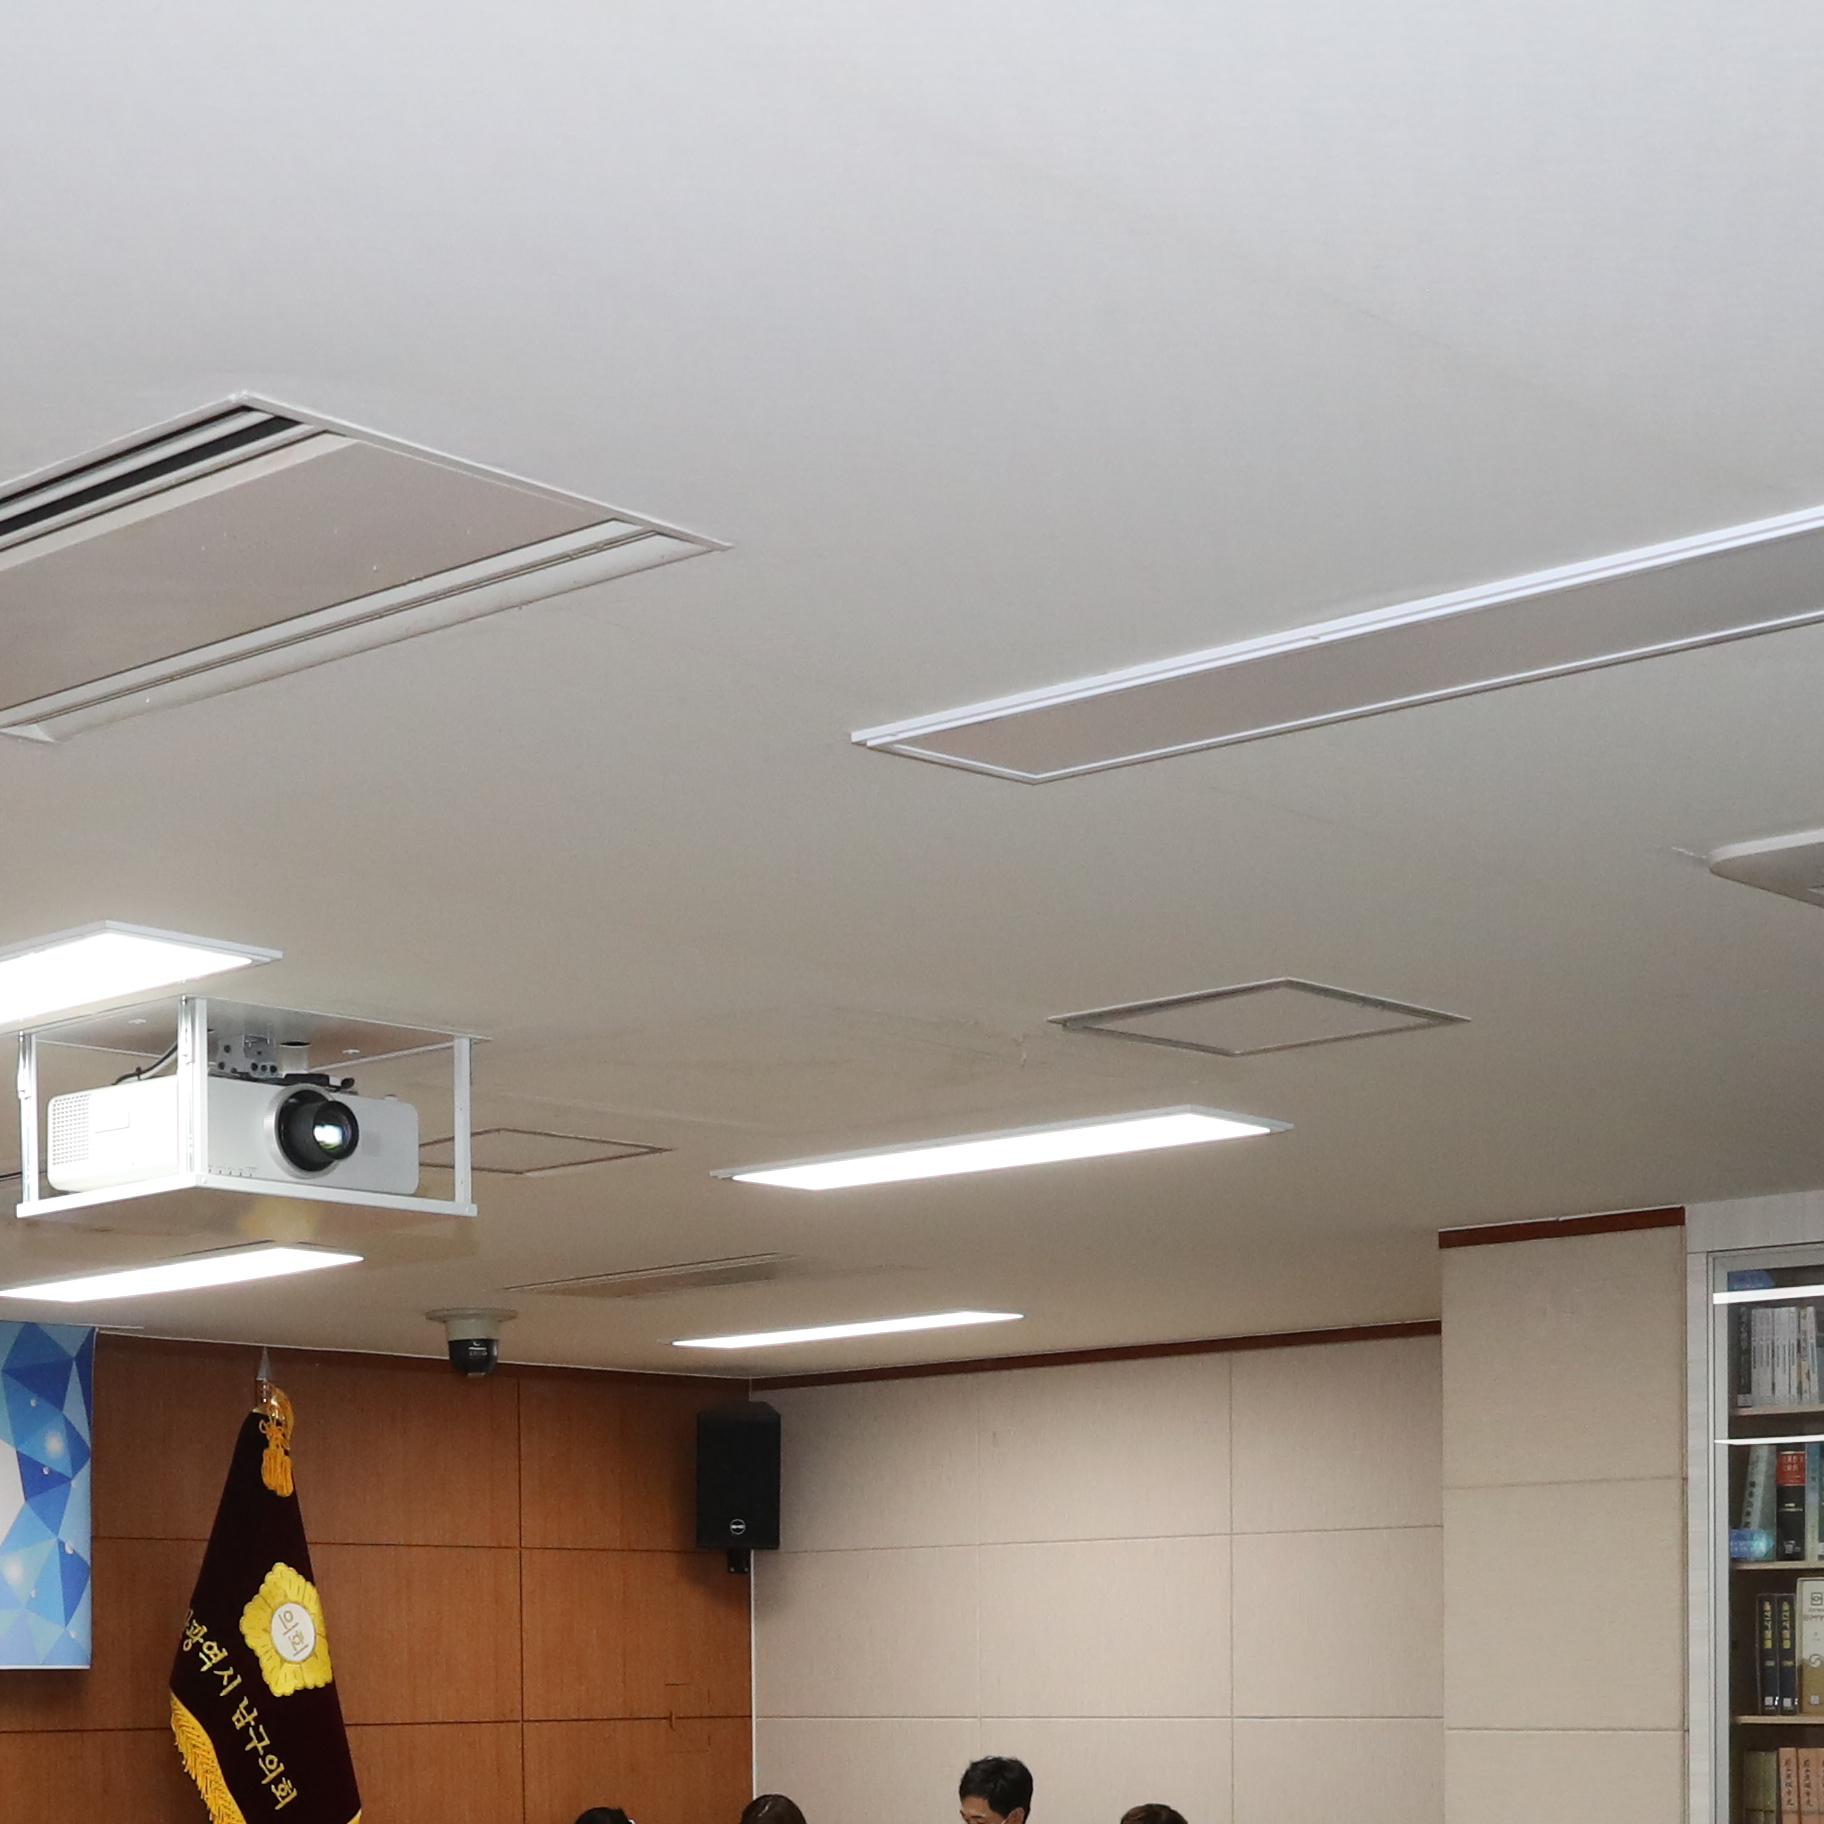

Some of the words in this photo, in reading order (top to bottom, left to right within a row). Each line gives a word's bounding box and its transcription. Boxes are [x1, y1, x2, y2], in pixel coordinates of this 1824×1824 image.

[279, 1610, 309, 1657] 의회
[182, 1609, 242, 1697] 광역시
[231, 1696, 298, 1810] 남구의회
